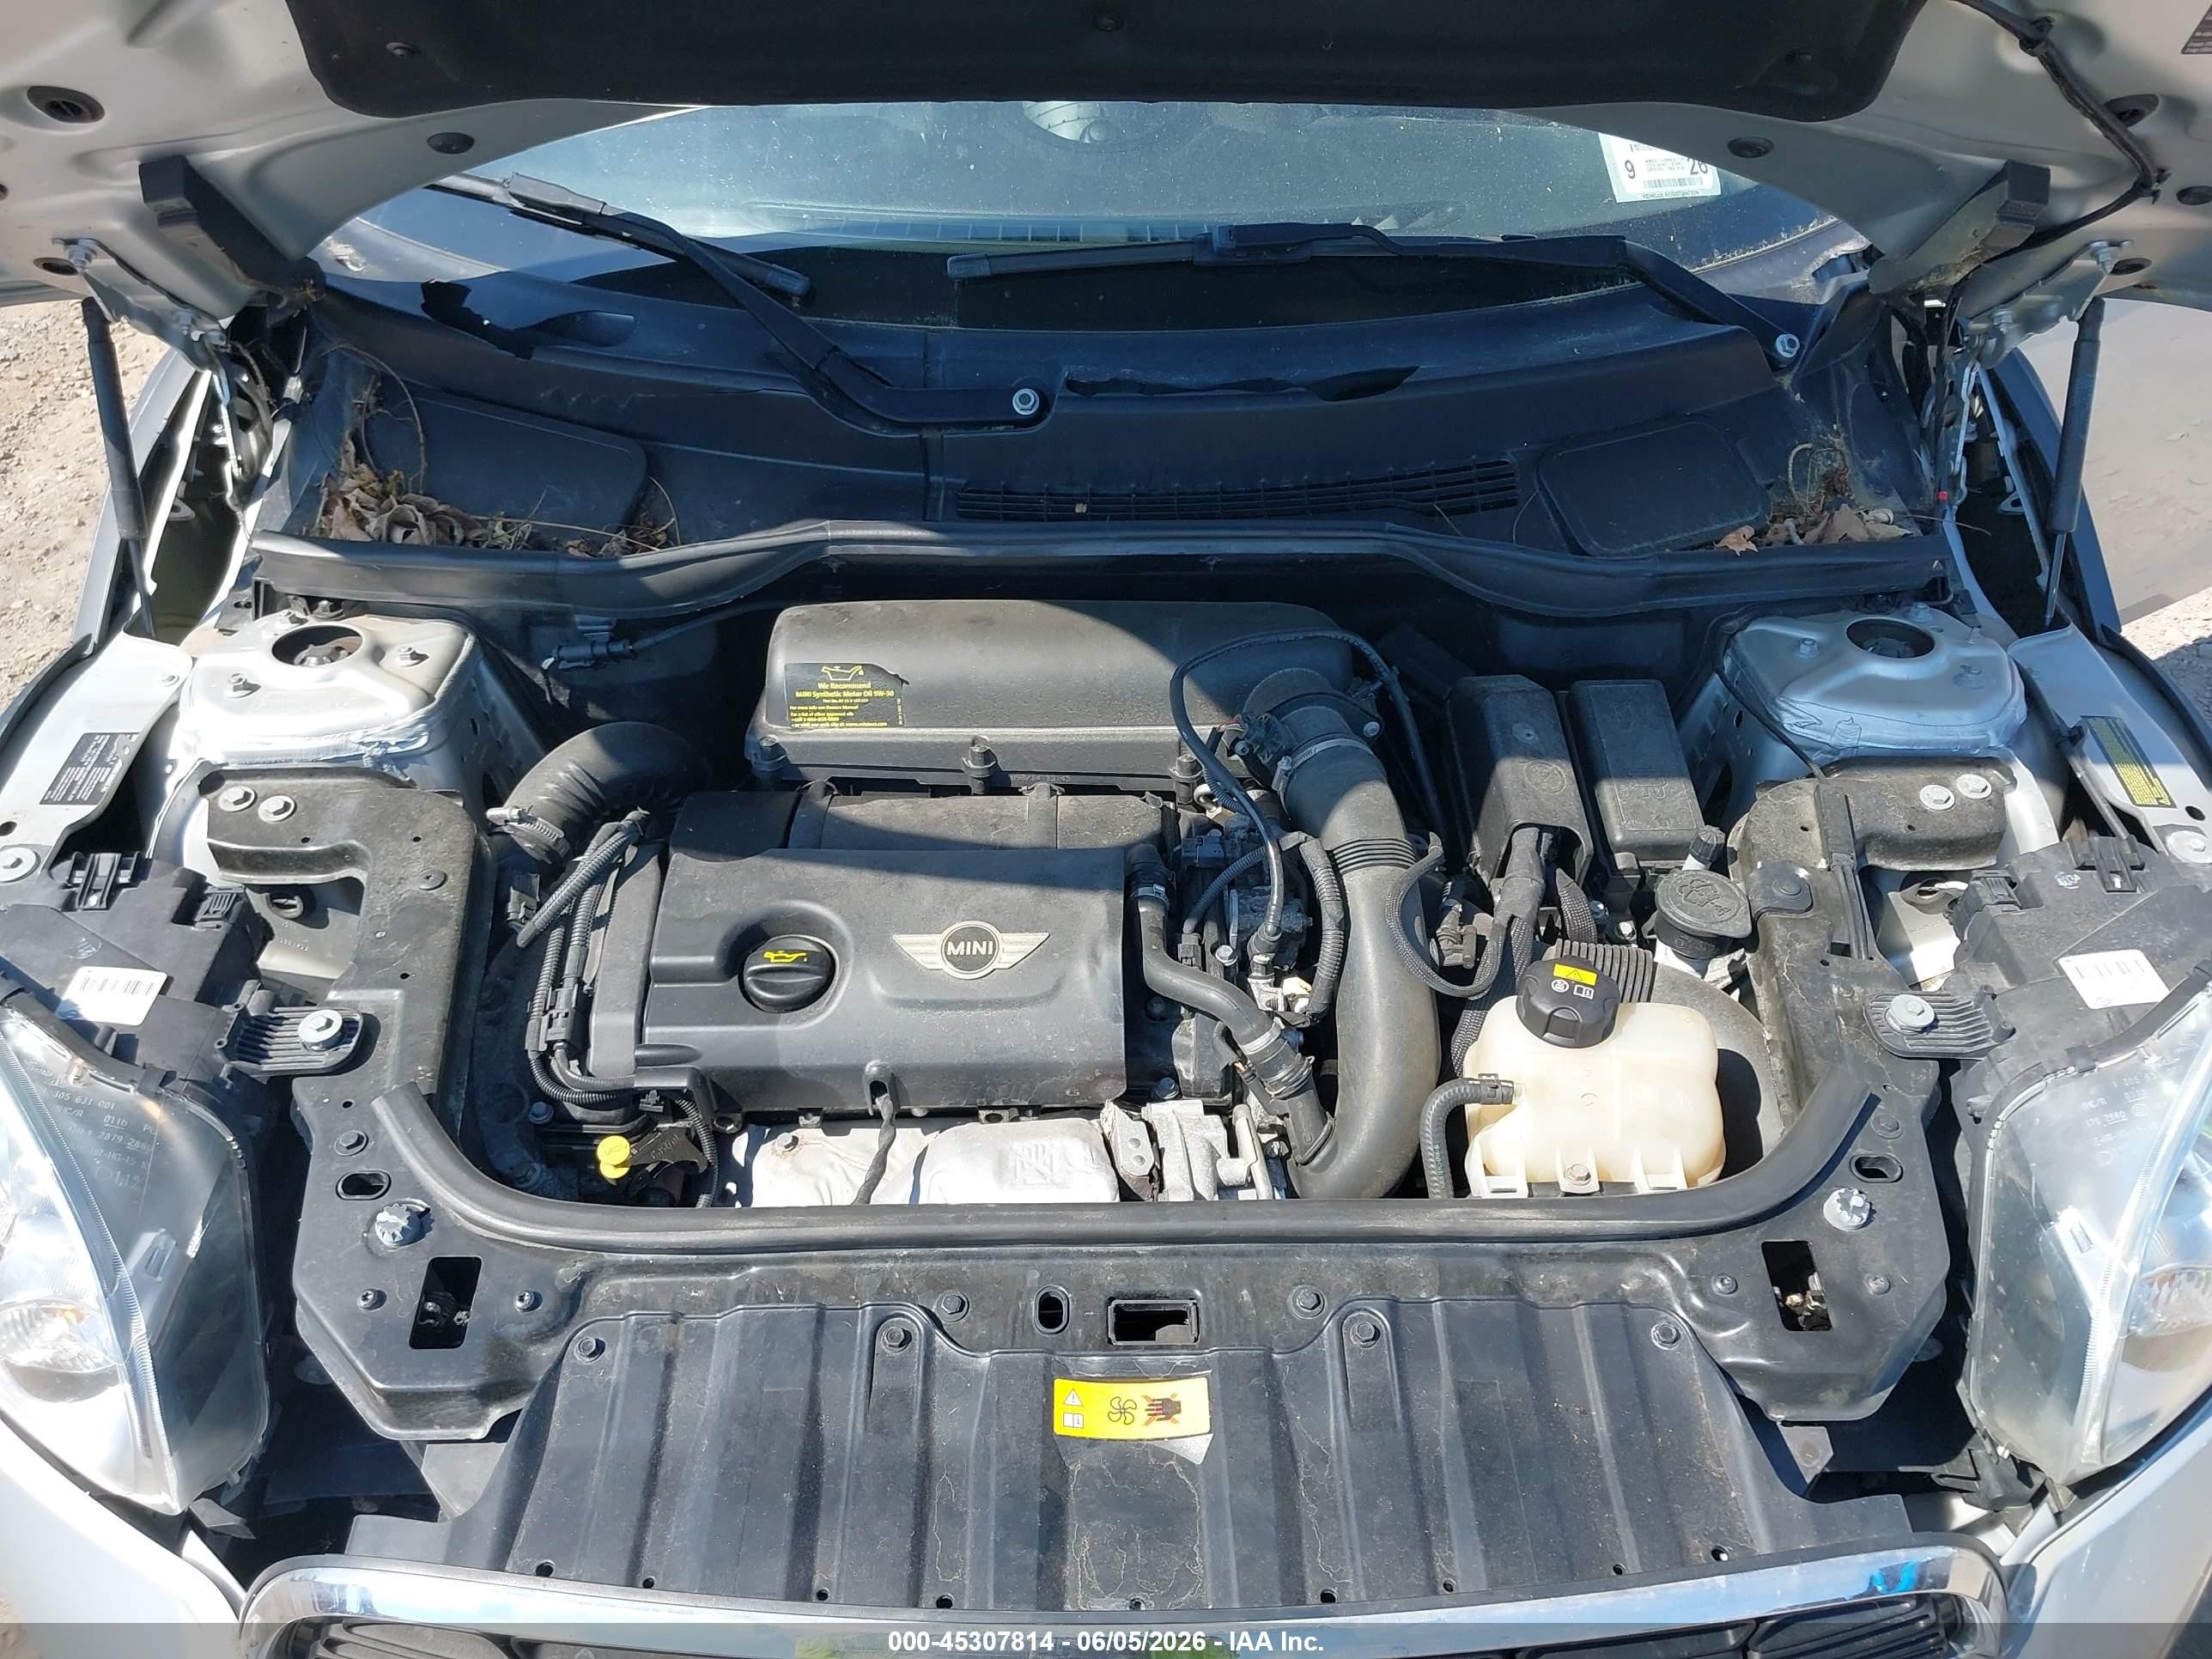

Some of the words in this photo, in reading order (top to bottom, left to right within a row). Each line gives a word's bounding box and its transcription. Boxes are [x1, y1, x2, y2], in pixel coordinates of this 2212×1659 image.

[1625, 160, 1636, 179] 9
[812, 690, 842, 699] Synthetic
[946, 940, 994, 956] MINI
